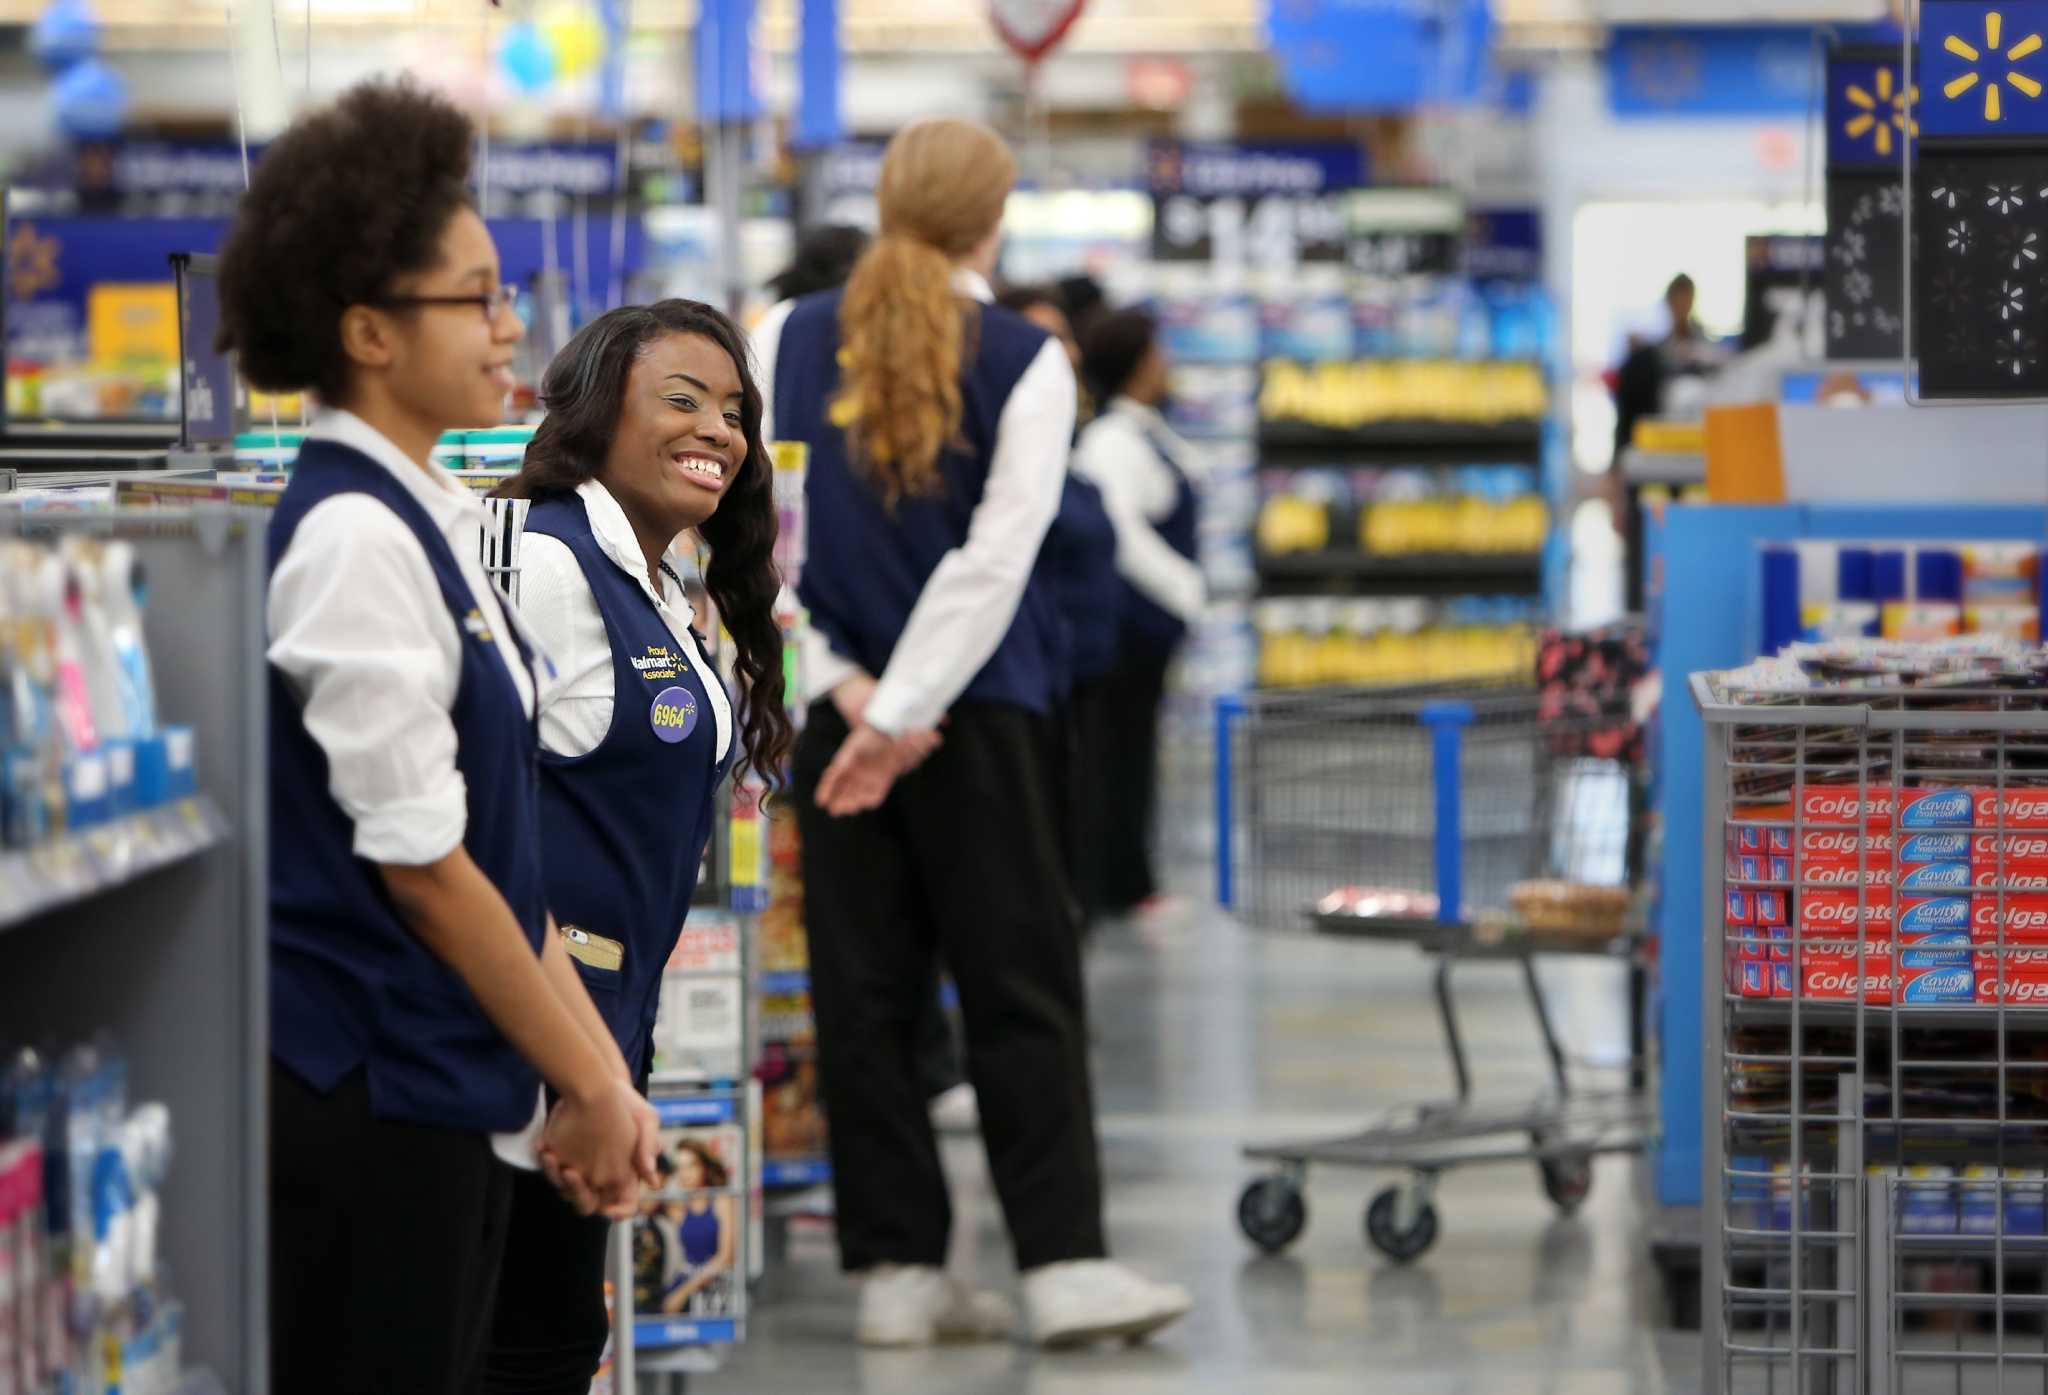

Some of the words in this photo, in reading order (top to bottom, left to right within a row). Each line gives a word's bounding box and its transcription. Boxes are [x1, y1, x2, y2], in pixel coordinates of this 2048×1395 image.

[647, 646, 668, 656] Proud
[642, 669, 677, 680] Associate
[653, 703, 685, 728] 6964
[1804, 796, 1901, 819] Colgate
[1918, 799, 1958, 812] Cavity
[1915, 809, 1955, 817] Protection
[1803, 832, 1900, 854] Colgate
[1917, 833, 1955, 847] Cavity
[1976, 835, 2048, 858] Colga
[1918, 869, 1957, 882] Cavity
[1804, 901, 1900, 924] Colgate
[1917, 904, 1957, 917] Cavity
[1914, 915, 1953, 924] Protection
[1976, 906, 2048, 929] Colga
[1807, 972, 1903, 994] Colgate
[1921, 975, 1961, 987] Cavity
[1918, 984, 1959, 993] Protection
